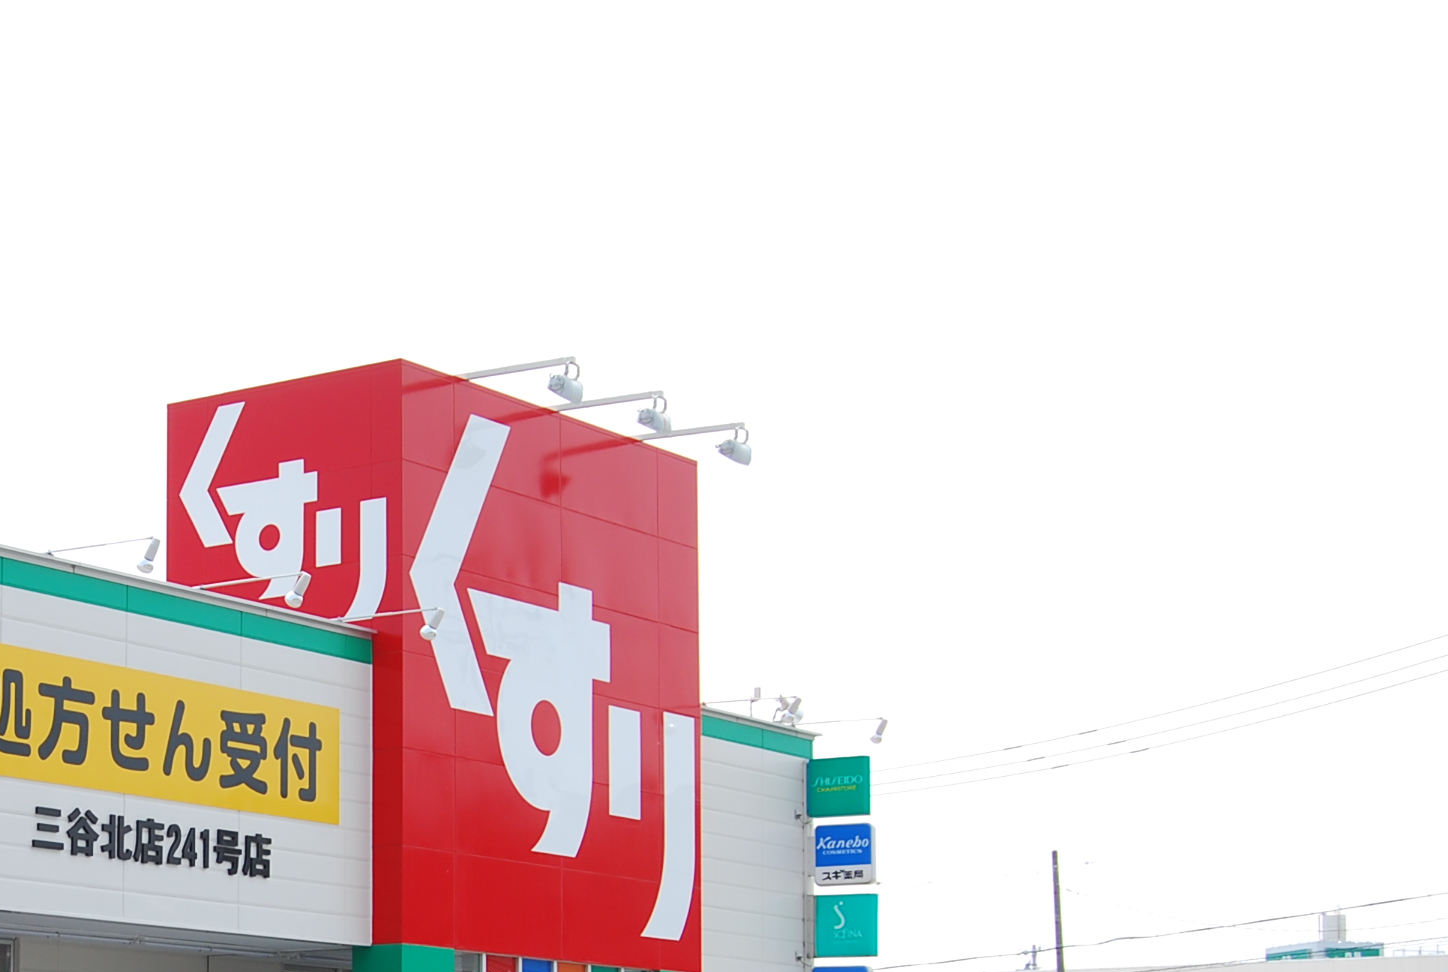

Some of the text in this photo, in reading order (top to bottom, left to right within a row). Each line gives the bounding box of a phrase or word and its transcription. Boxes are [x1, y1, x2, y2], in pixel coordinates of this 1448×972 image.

[179, 401, 387, 619] くすり
[409, 413, 696, 941] くすり
[811, 774, 863, 788] SHISEIDO
[31, 806, 272, 878] 三谷北店241号店
[816, 835, 869, 850] Kanebo
[822, 869, 863, 881] スギ薬局
[833, 929, 862, 939] SOFINA
